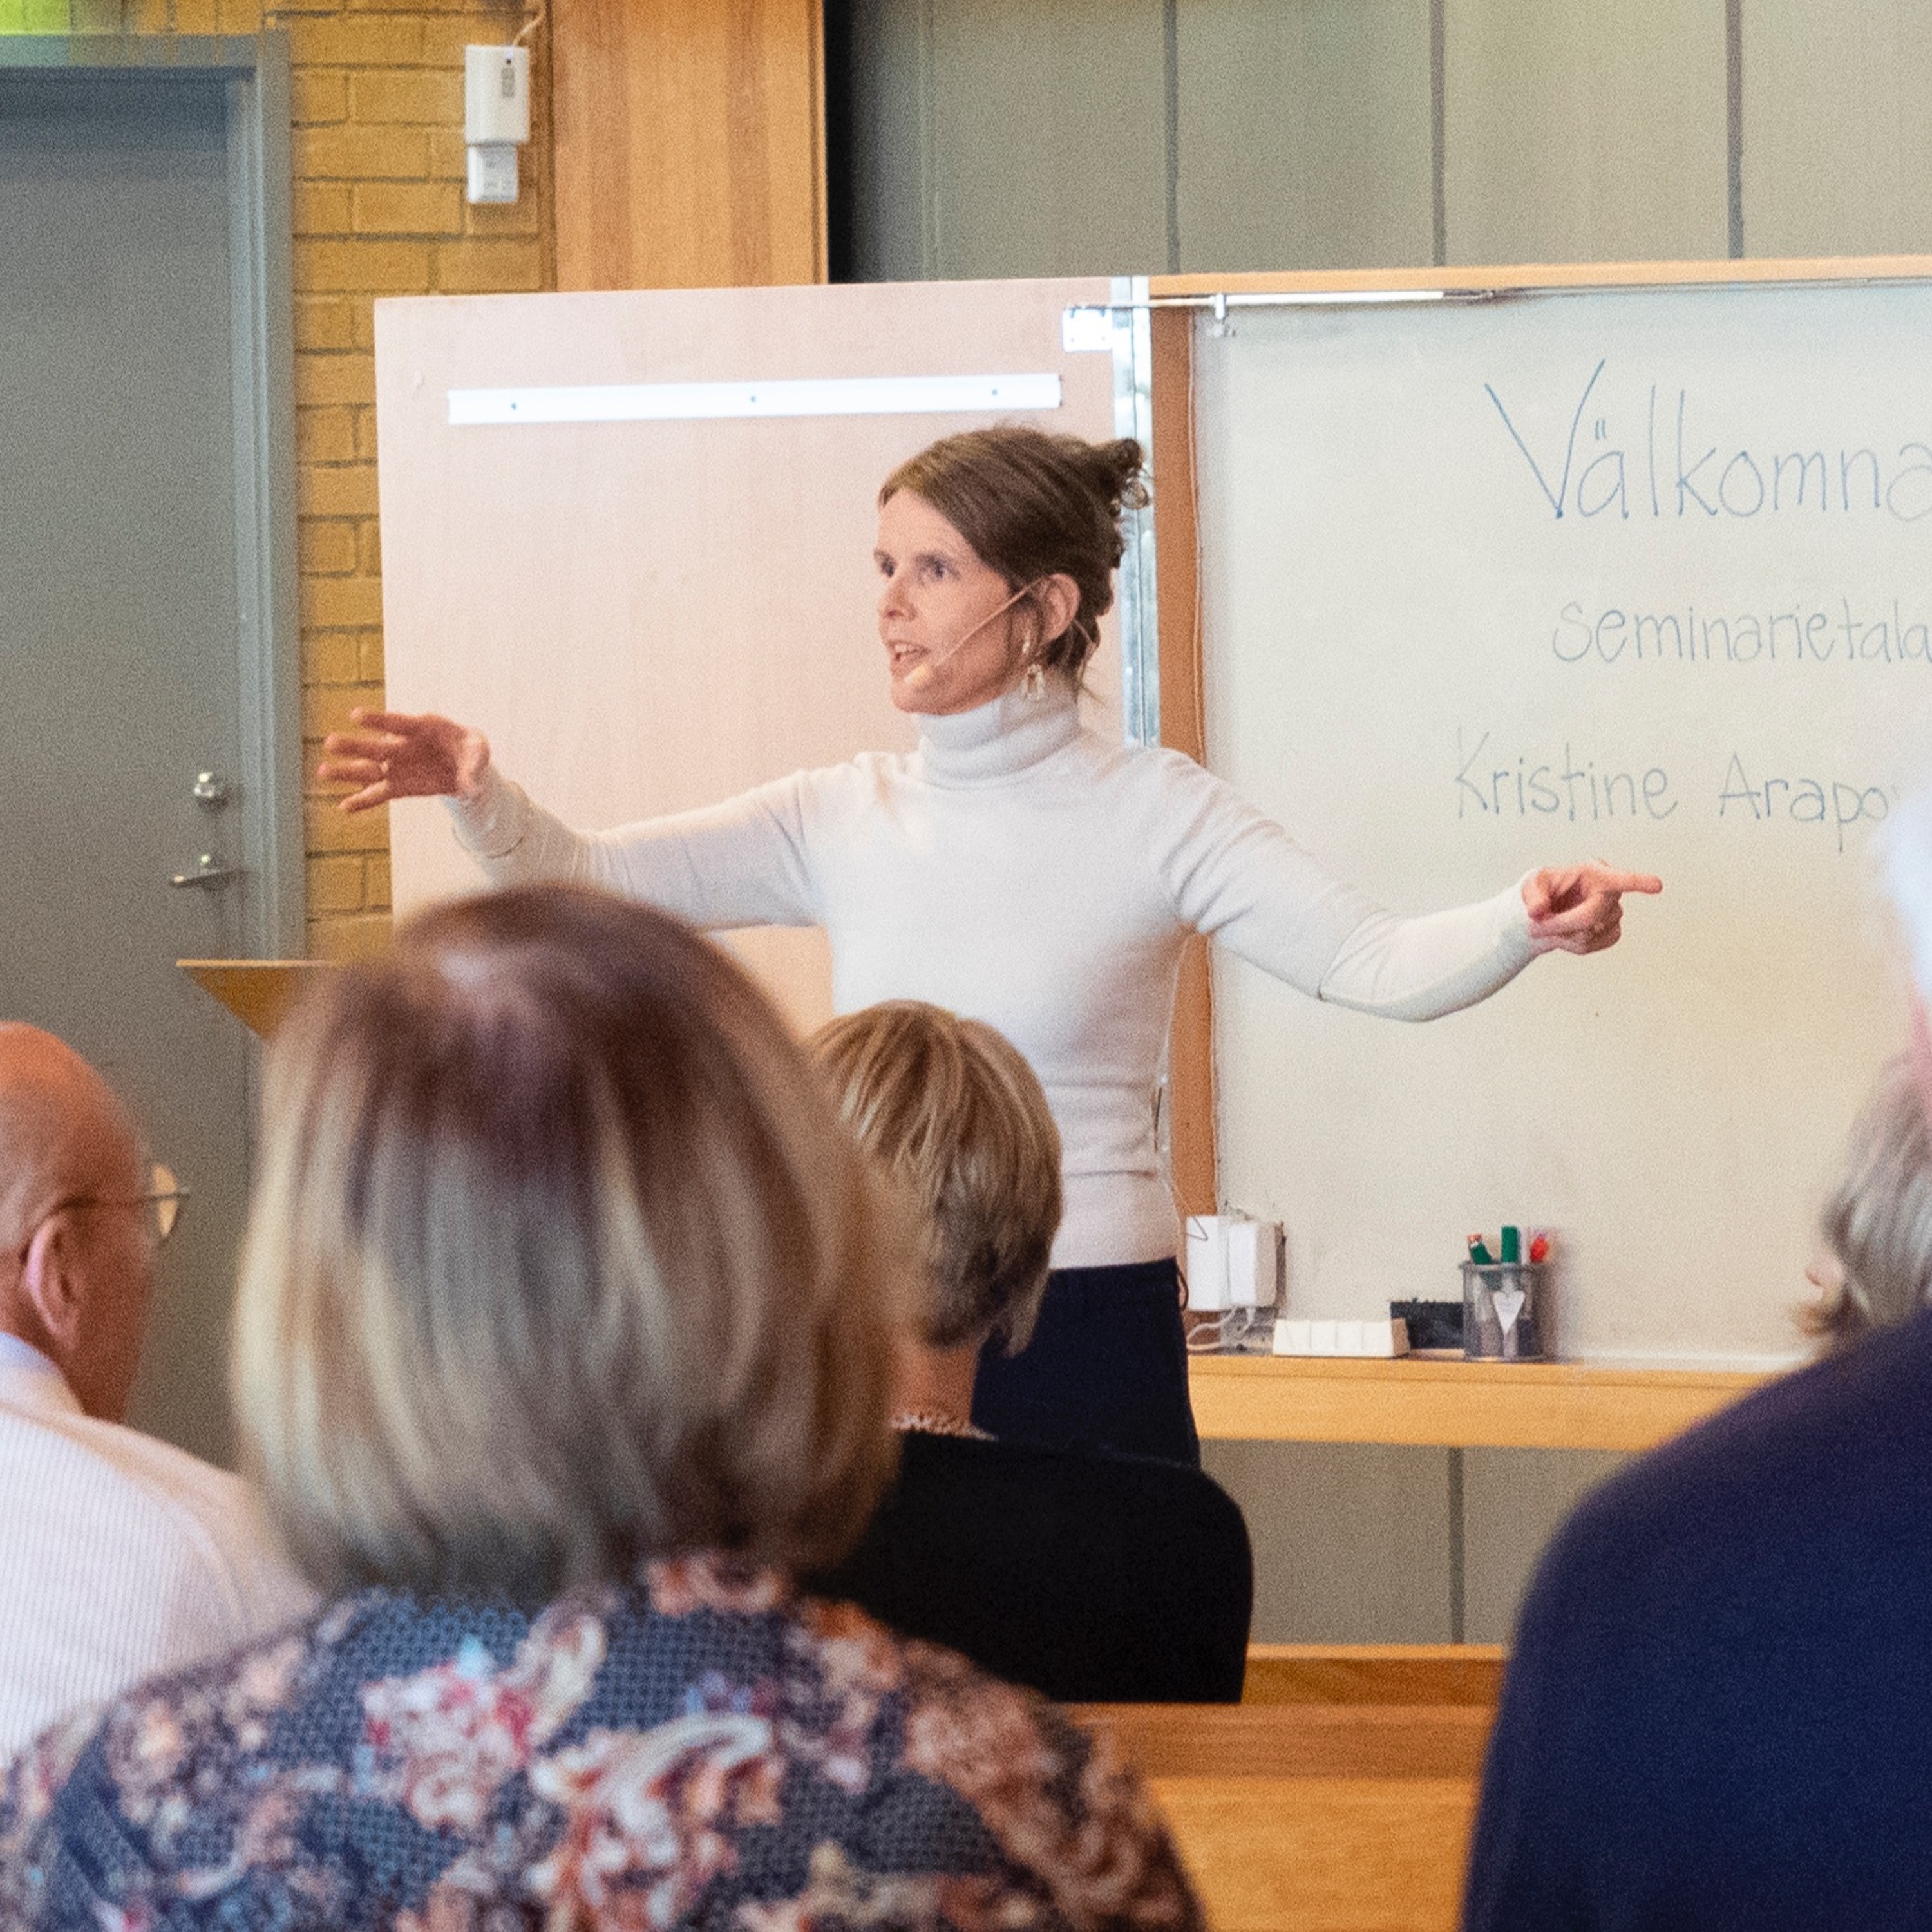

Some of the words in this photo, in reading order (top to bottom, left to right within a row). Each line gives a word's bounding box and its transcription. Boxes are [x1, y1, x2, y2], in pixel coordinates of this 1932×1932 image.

[1483, 358, 1932, 522] Välkomna
[1453, 725, 1678, 822] Kristine
[1718, 751, 1900, 852] Arapo
